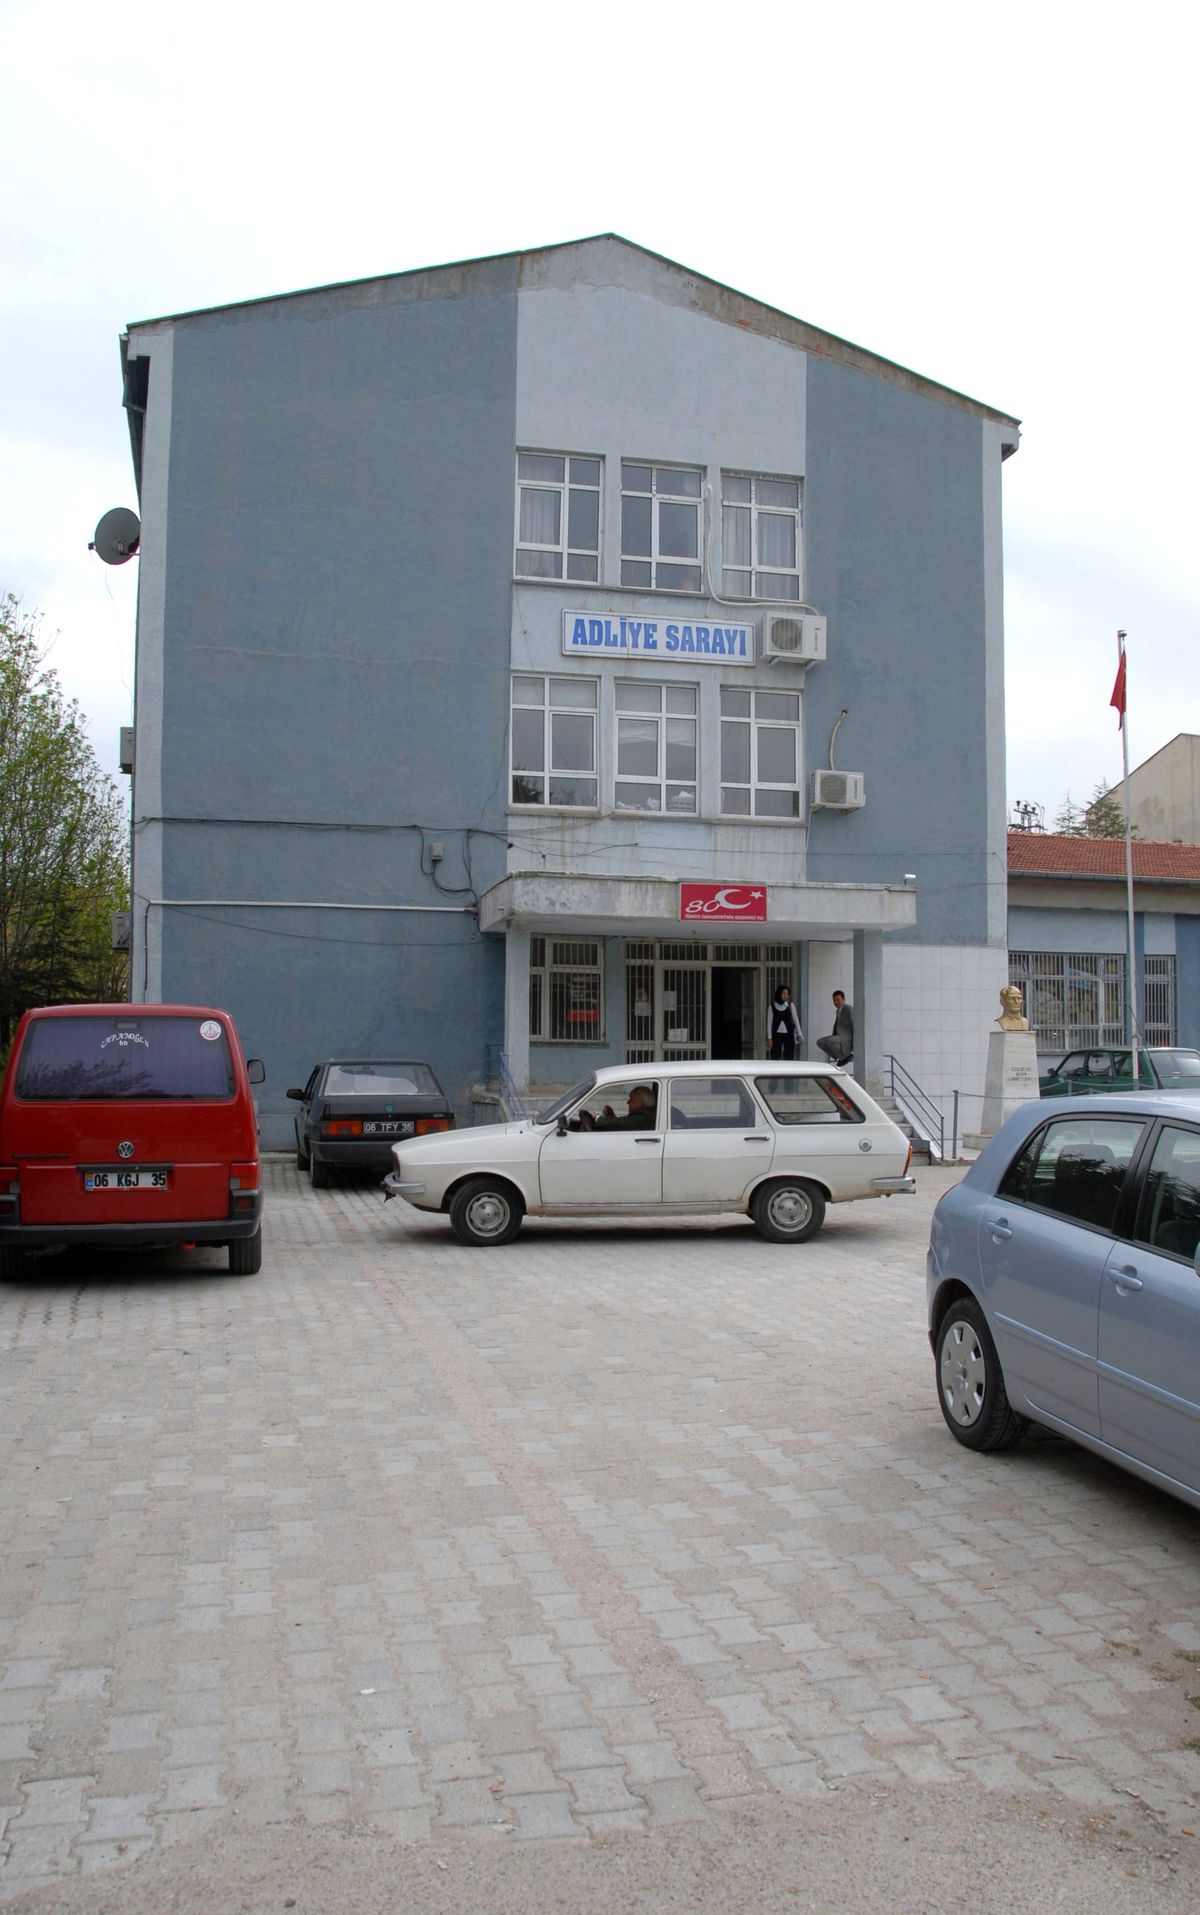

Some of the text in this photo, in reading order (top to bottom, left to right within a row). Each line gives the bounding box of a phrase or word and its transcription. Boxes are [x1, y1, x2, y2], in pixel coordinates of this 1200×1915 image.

[572, 616, 747, 655] ADLİYE SARAYI
[685, 900, 720, 913] 80
[365, 1123, 376, 1131] 06
[380, 1123, 399, 1131] TFY
[94, 1173, 109, 1187] 06
[151, 1172, 166, 1186] 35
